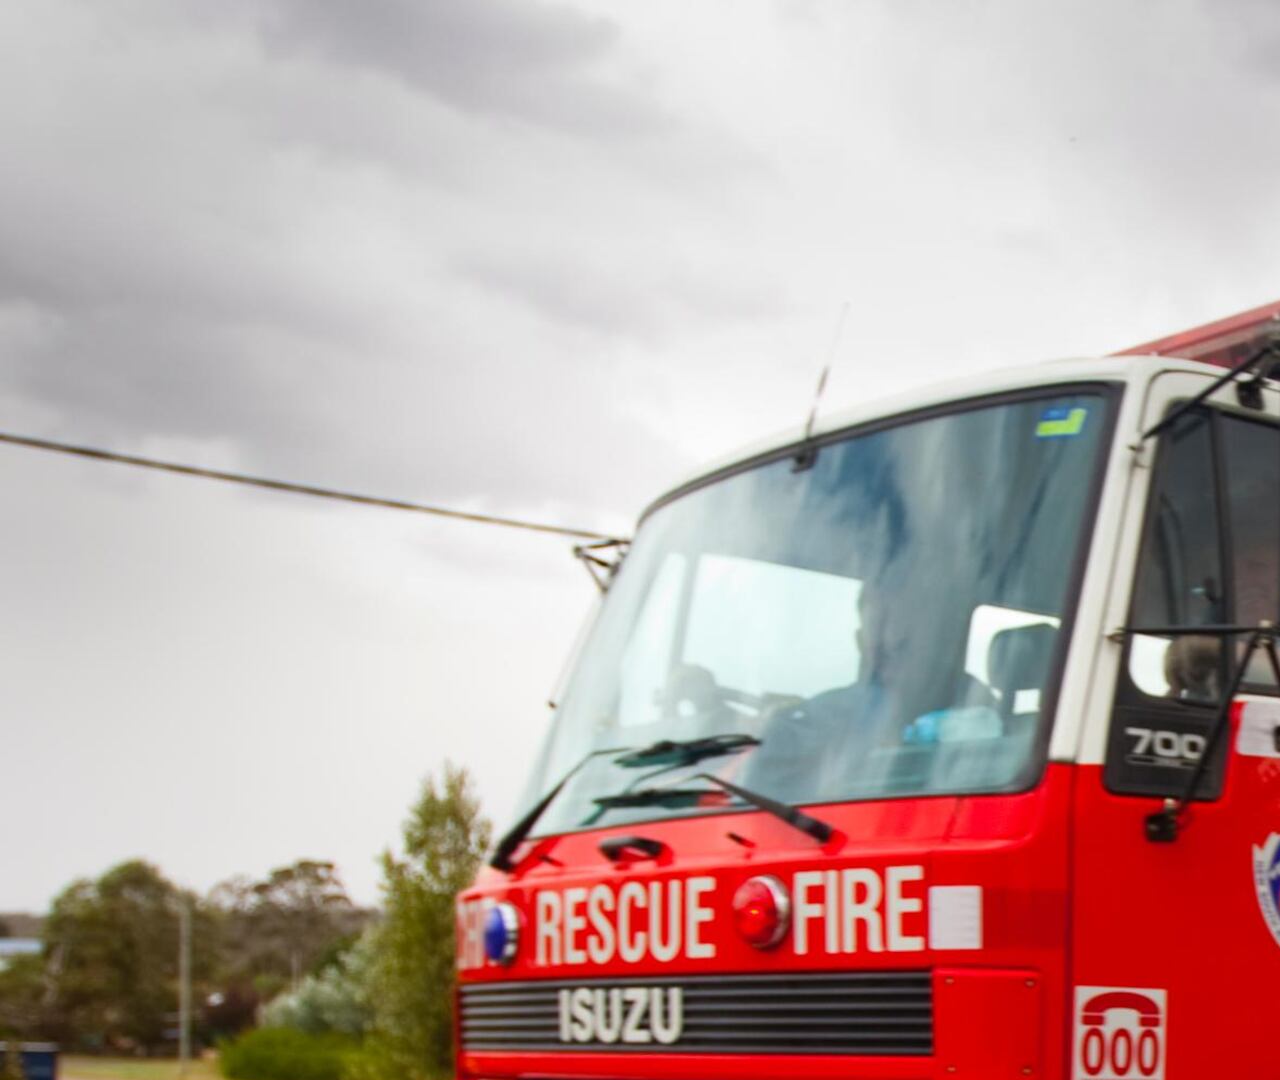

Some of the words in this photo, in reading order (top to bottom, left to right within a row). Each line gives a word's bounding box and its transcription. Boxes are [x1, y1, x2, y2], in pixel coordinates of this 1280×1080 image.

[1125, 727, 1206, 759] 700
[536, 877, 716, 966] RESCUE
[793, 865, 925, 955] FIRE
[558, 987, 683, 1044] ISUZU
[1080, 1027, 1161, 1078] 000
